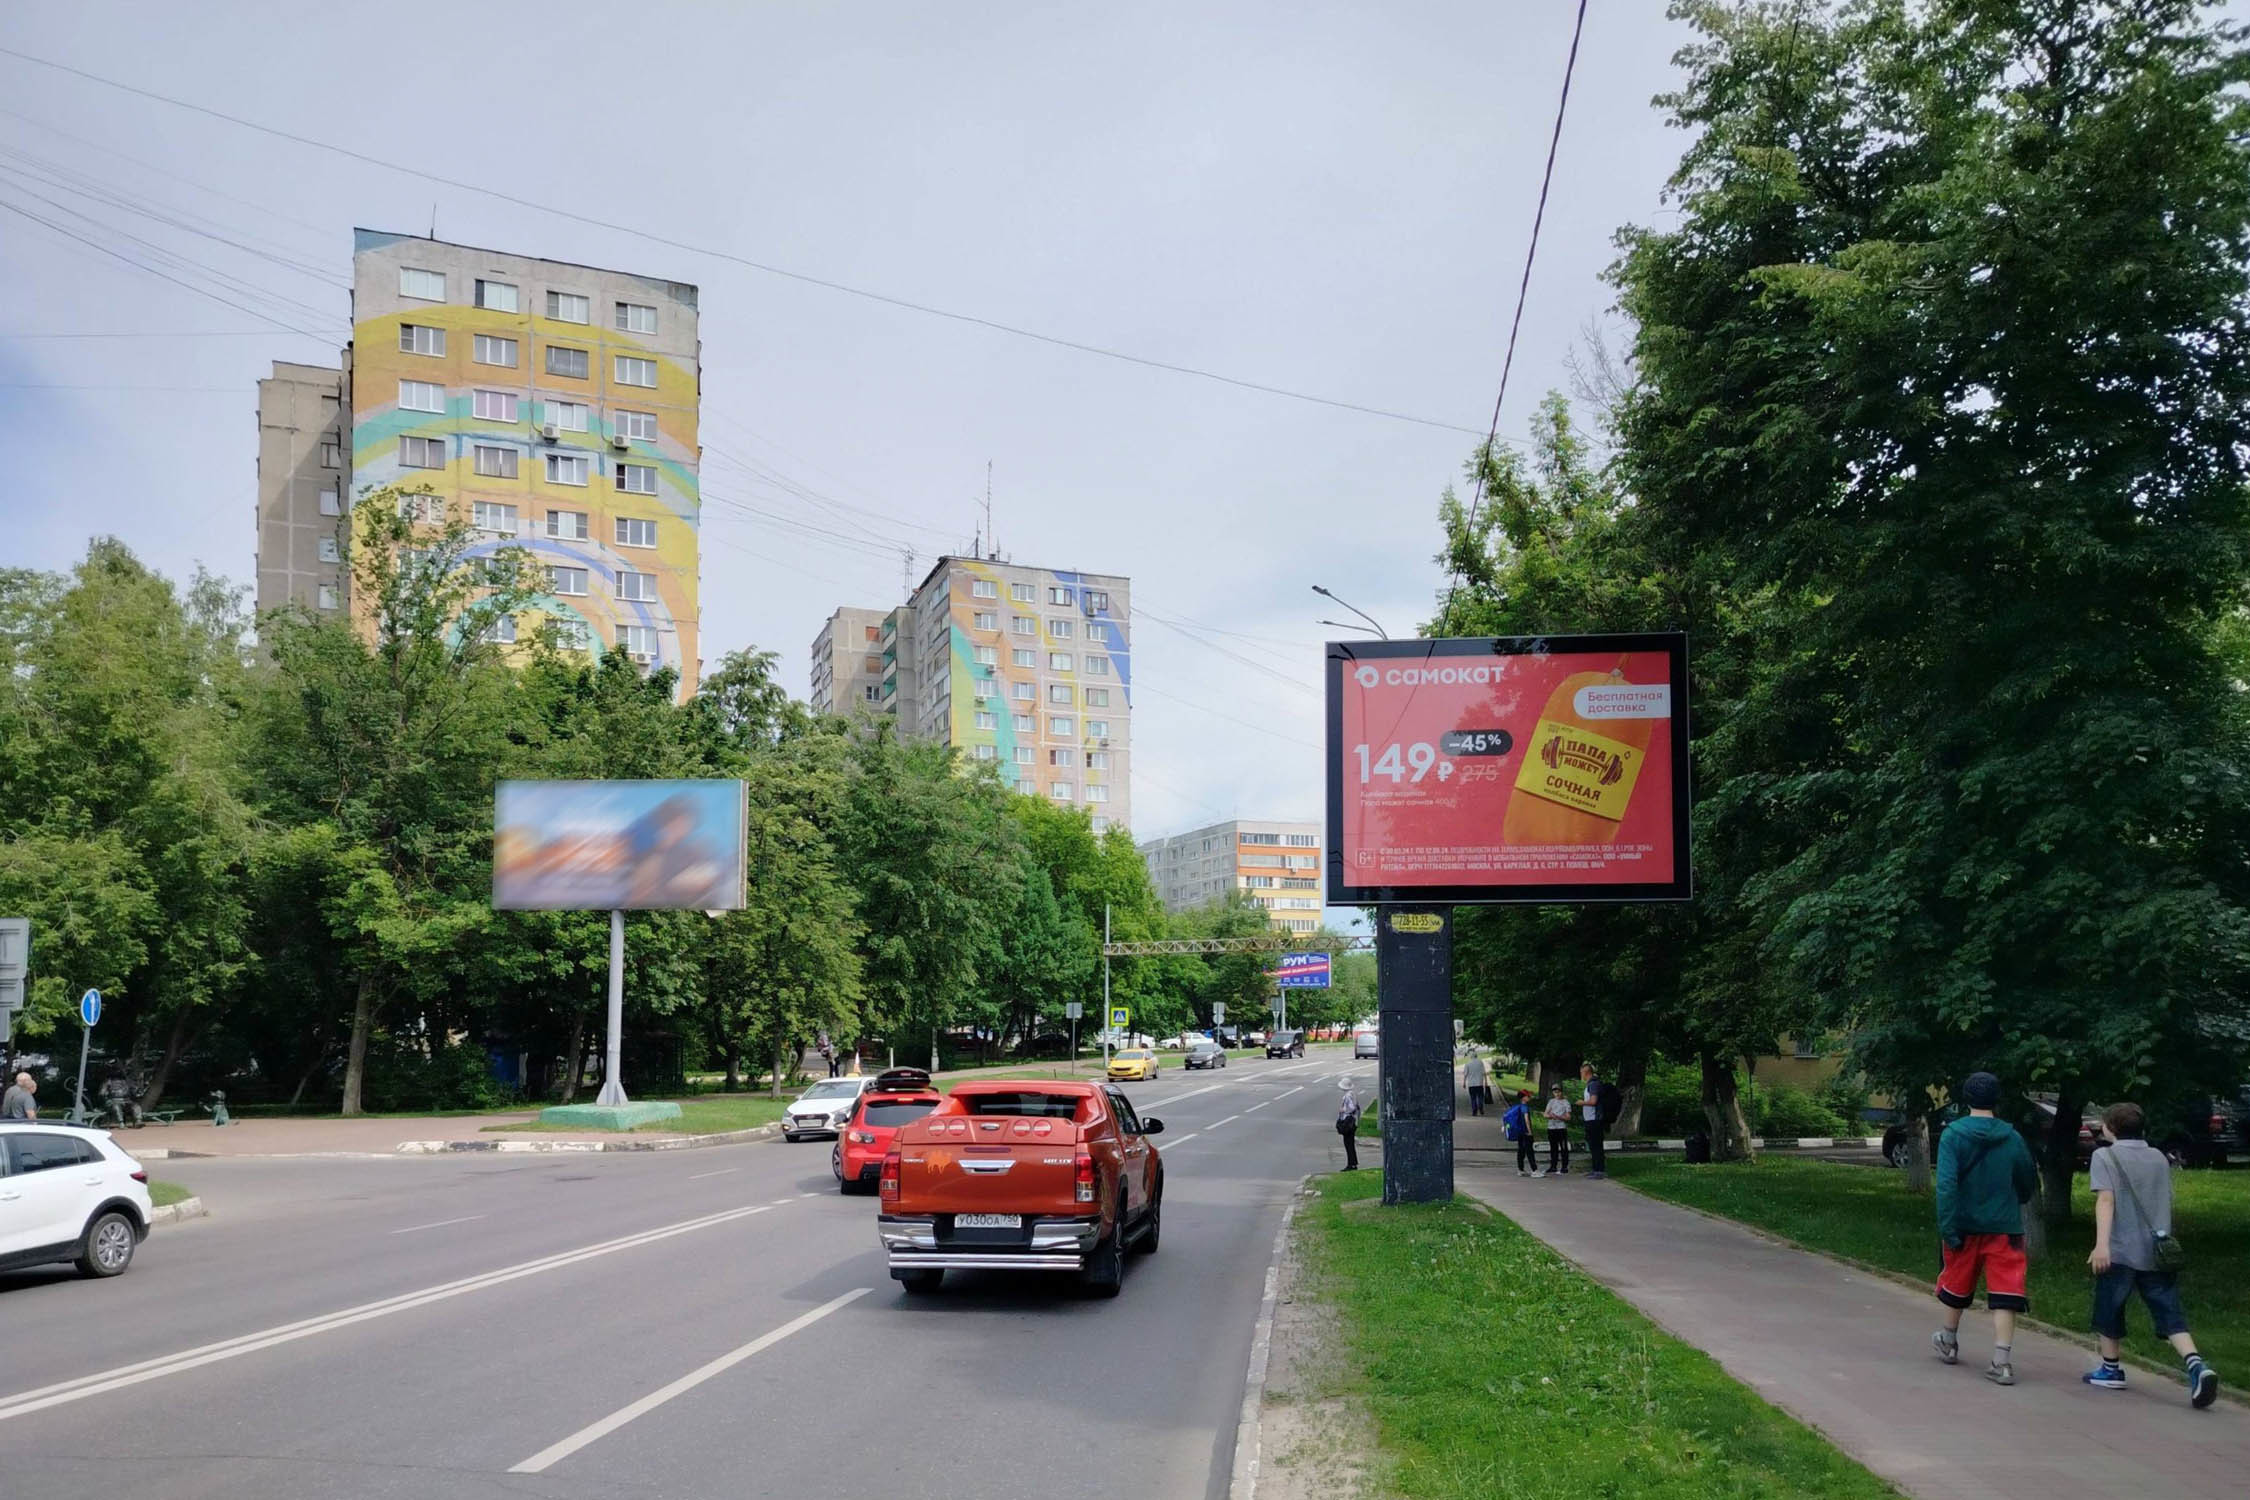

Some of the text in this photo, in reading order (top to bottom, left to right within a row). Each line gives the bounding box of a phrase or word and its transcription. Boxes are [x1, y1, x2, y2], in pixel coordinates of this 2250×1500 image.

[1386, 666, 1505, 686] самокат
[1588, 691, 1663, 703] Бесплатная
[1588, 704, 1647, 714] доставка
[1449, 733, 1502, 752] -45%
[1566, 740, 1608, 763] ПАПА
[1563, 757, 1601, 775] МОЖЕТ
[1546, 775, 1602, 802] СОЧНАЯ
